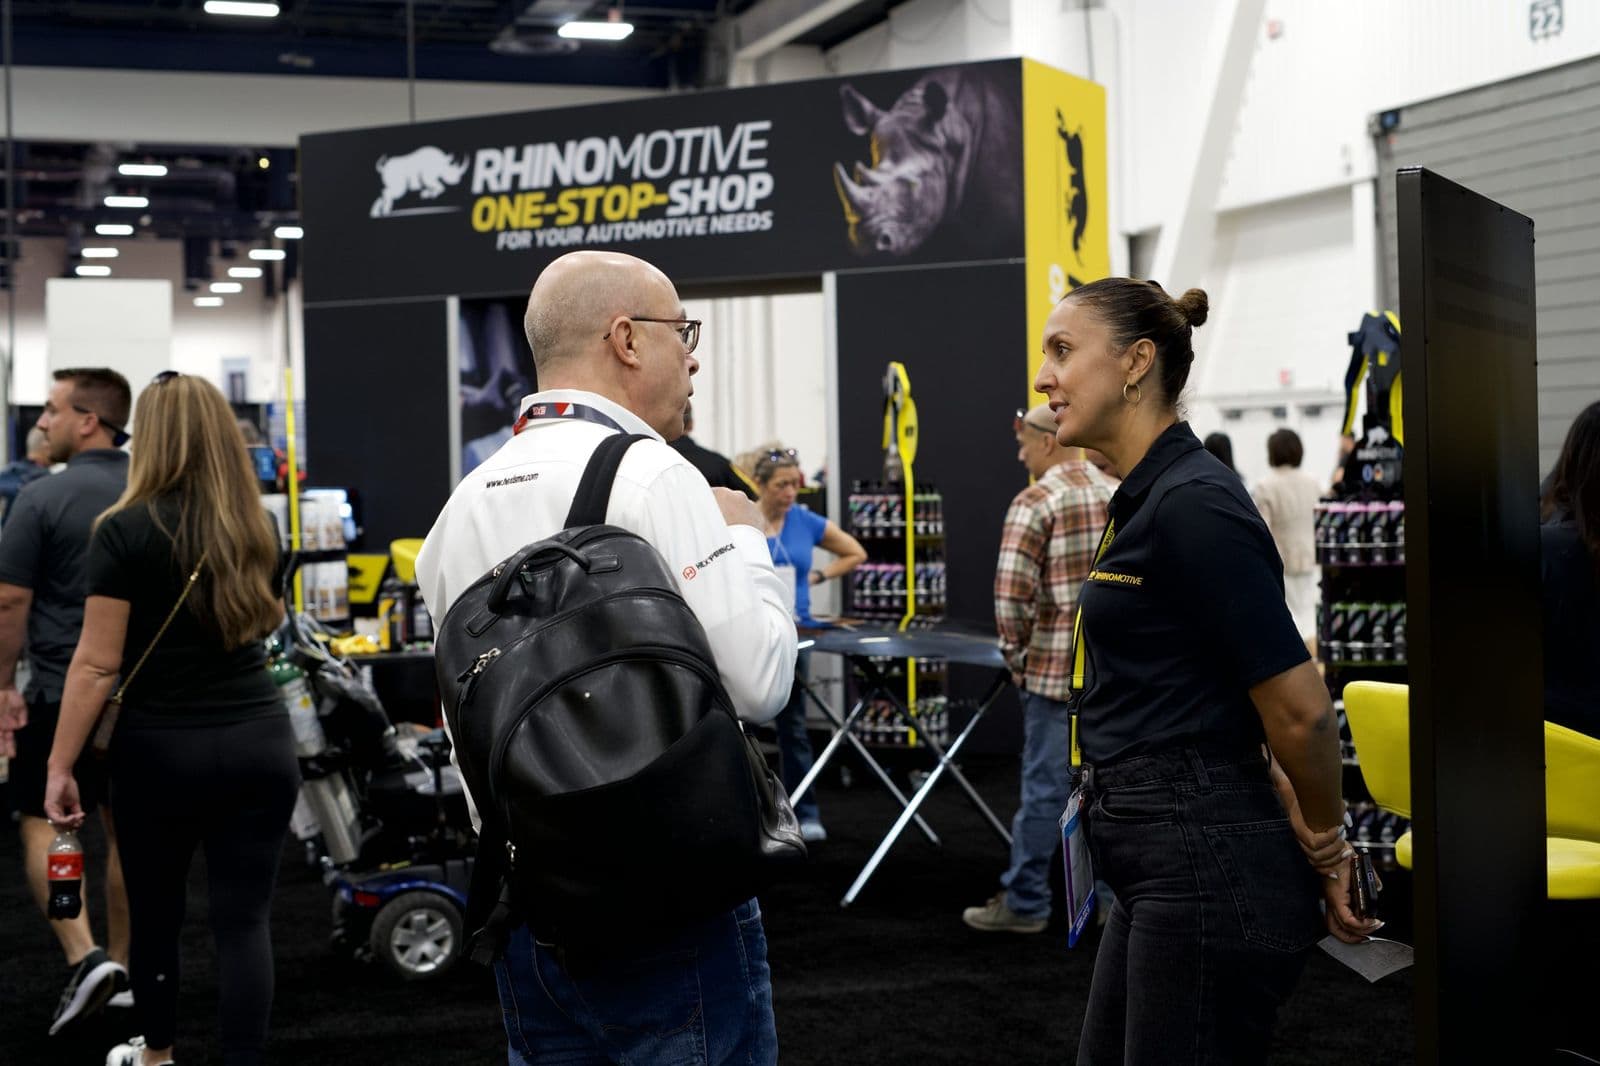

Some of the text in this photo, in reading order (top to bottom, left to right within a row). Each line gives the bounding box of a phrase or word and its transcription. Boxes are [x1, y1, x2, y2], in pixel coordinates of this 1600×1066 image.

[470, 120, 772, 194] RHINOMOTIVE
[497, 210, 774, 250] FOR YOUR AUTOMOTIVE NEEDS
